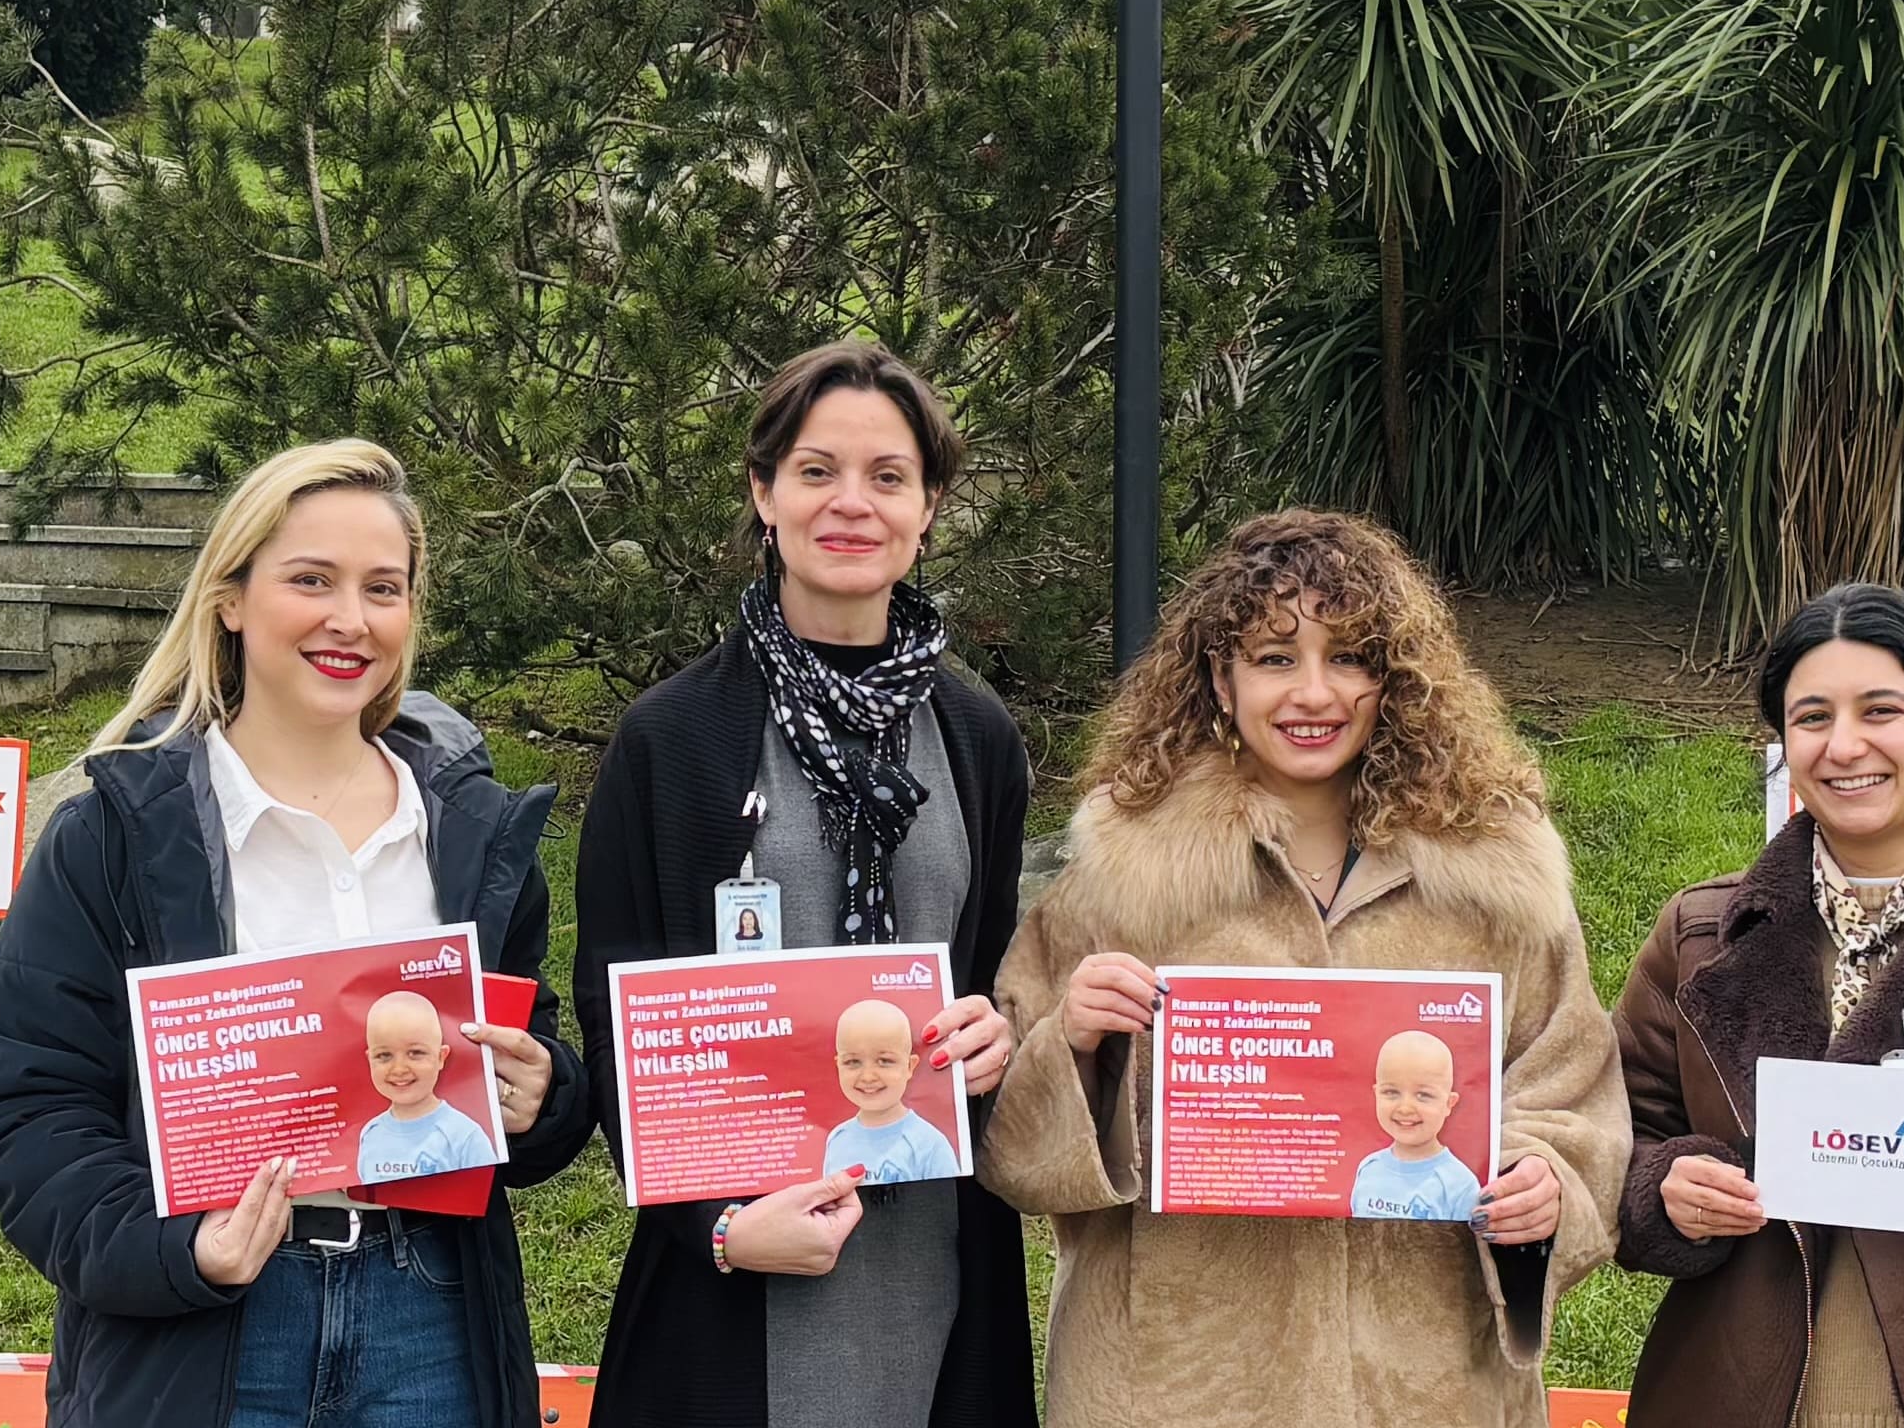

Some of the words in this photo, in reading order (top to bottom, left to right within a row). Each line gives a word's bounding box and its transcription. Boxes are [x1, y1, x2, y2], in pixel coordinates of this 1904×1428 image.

[149, 995, 210, 1012] Ramazan
[628, 992, 686, 1006] Ramazan
[1171, 999, 1229, 1012] Ramazan
[186, 1013, 201, 1023] ve
[663, 1010, 677, 1020] ve
[1205, 1018, 1220, 1028] ve
[154, 1031, 210, 1056] ÖNCE
[215, 1014, 322, 1051] ÇOCUKLAR
[631, 1027, 684, 1050] ÖNCE
[690, 1017, 793, 1049] ÇOCUKLAR
[1171, 1032, 1223, 1055] ÖNCE
[1230, 1037, 1334, 1061] ÇOCUKLAR
[158, 1049, 257, 1083] İYİLEŞSİN
[633, 1048, 729, 1077] İYİLEŞSİN
[1171, 1059, 1267, 1087] İYİLEŞSİN
[1812, 1129, 1902, 1154] LÖSEV
[1811, 1152, 1858, 1165] Lösemili
